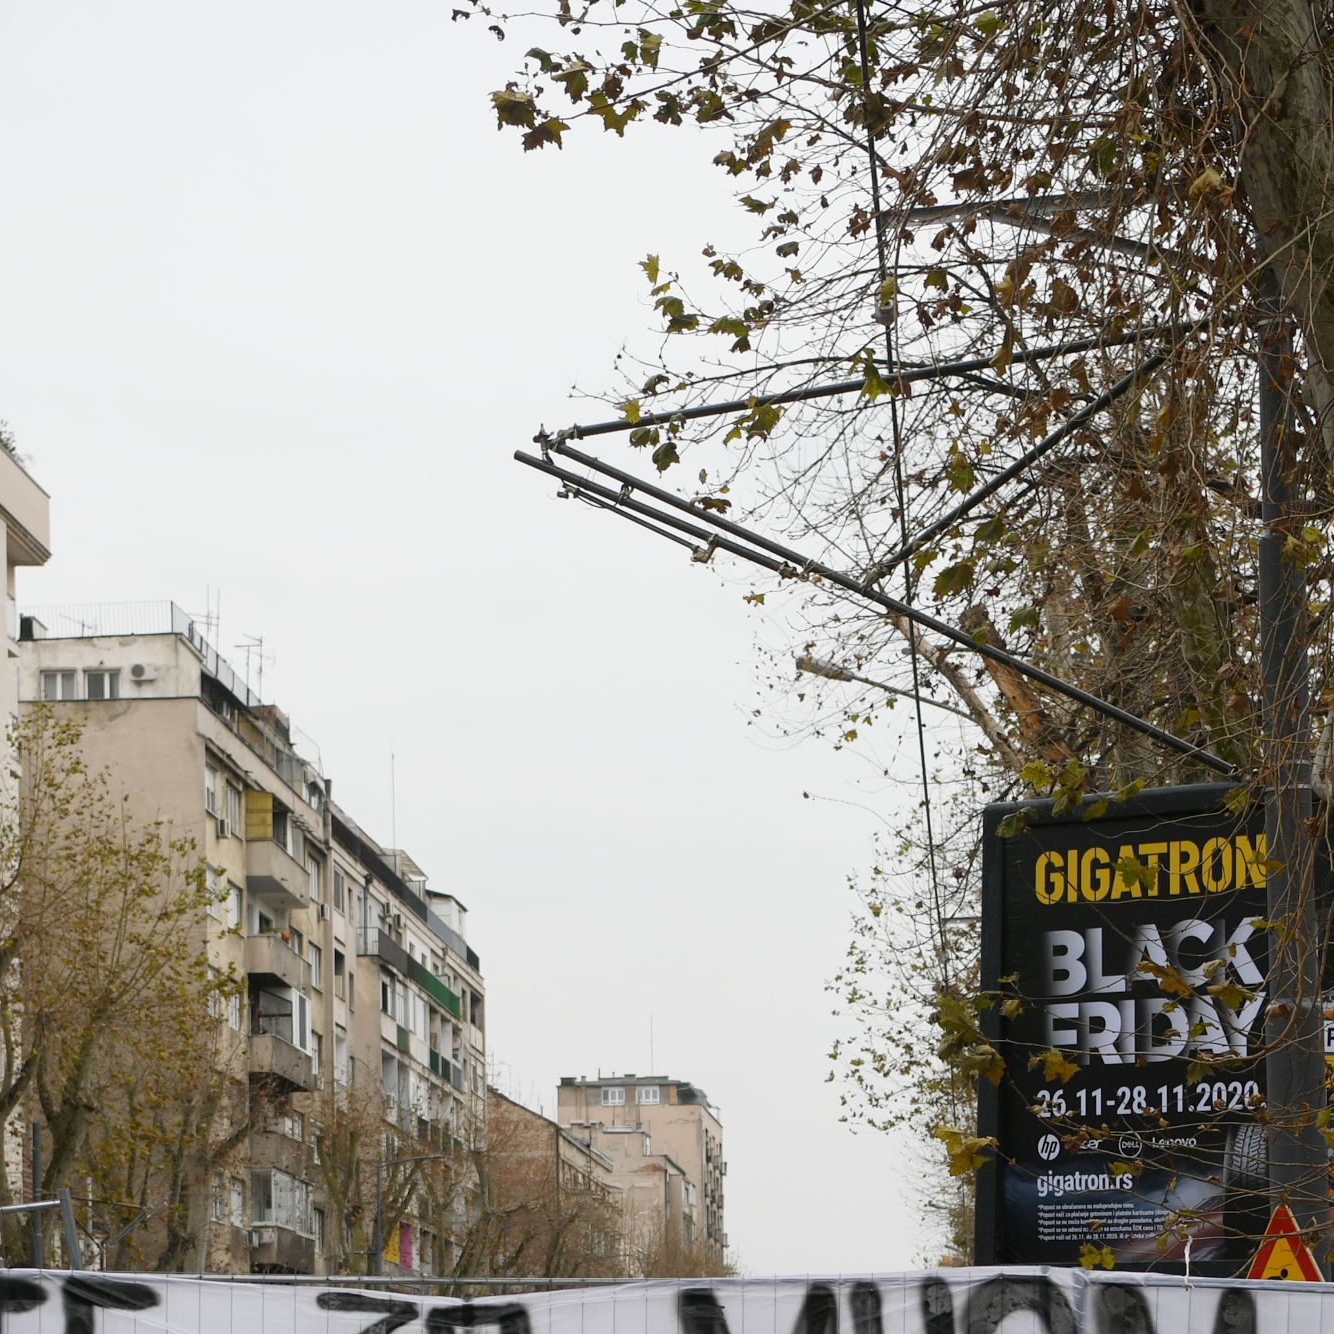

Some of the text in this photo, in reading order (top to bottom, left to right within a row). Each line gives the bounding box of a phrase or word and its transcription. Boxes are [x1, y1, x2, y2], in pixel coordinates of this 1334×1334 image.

[1035, 834, 1267, 905] GIGATRON
[1044, 915, 1265, 997] BLACK
[1045, 991, 1267, 1066] FRIDAY
[1036, 1170, 1134, 1198] gigatron.rs
